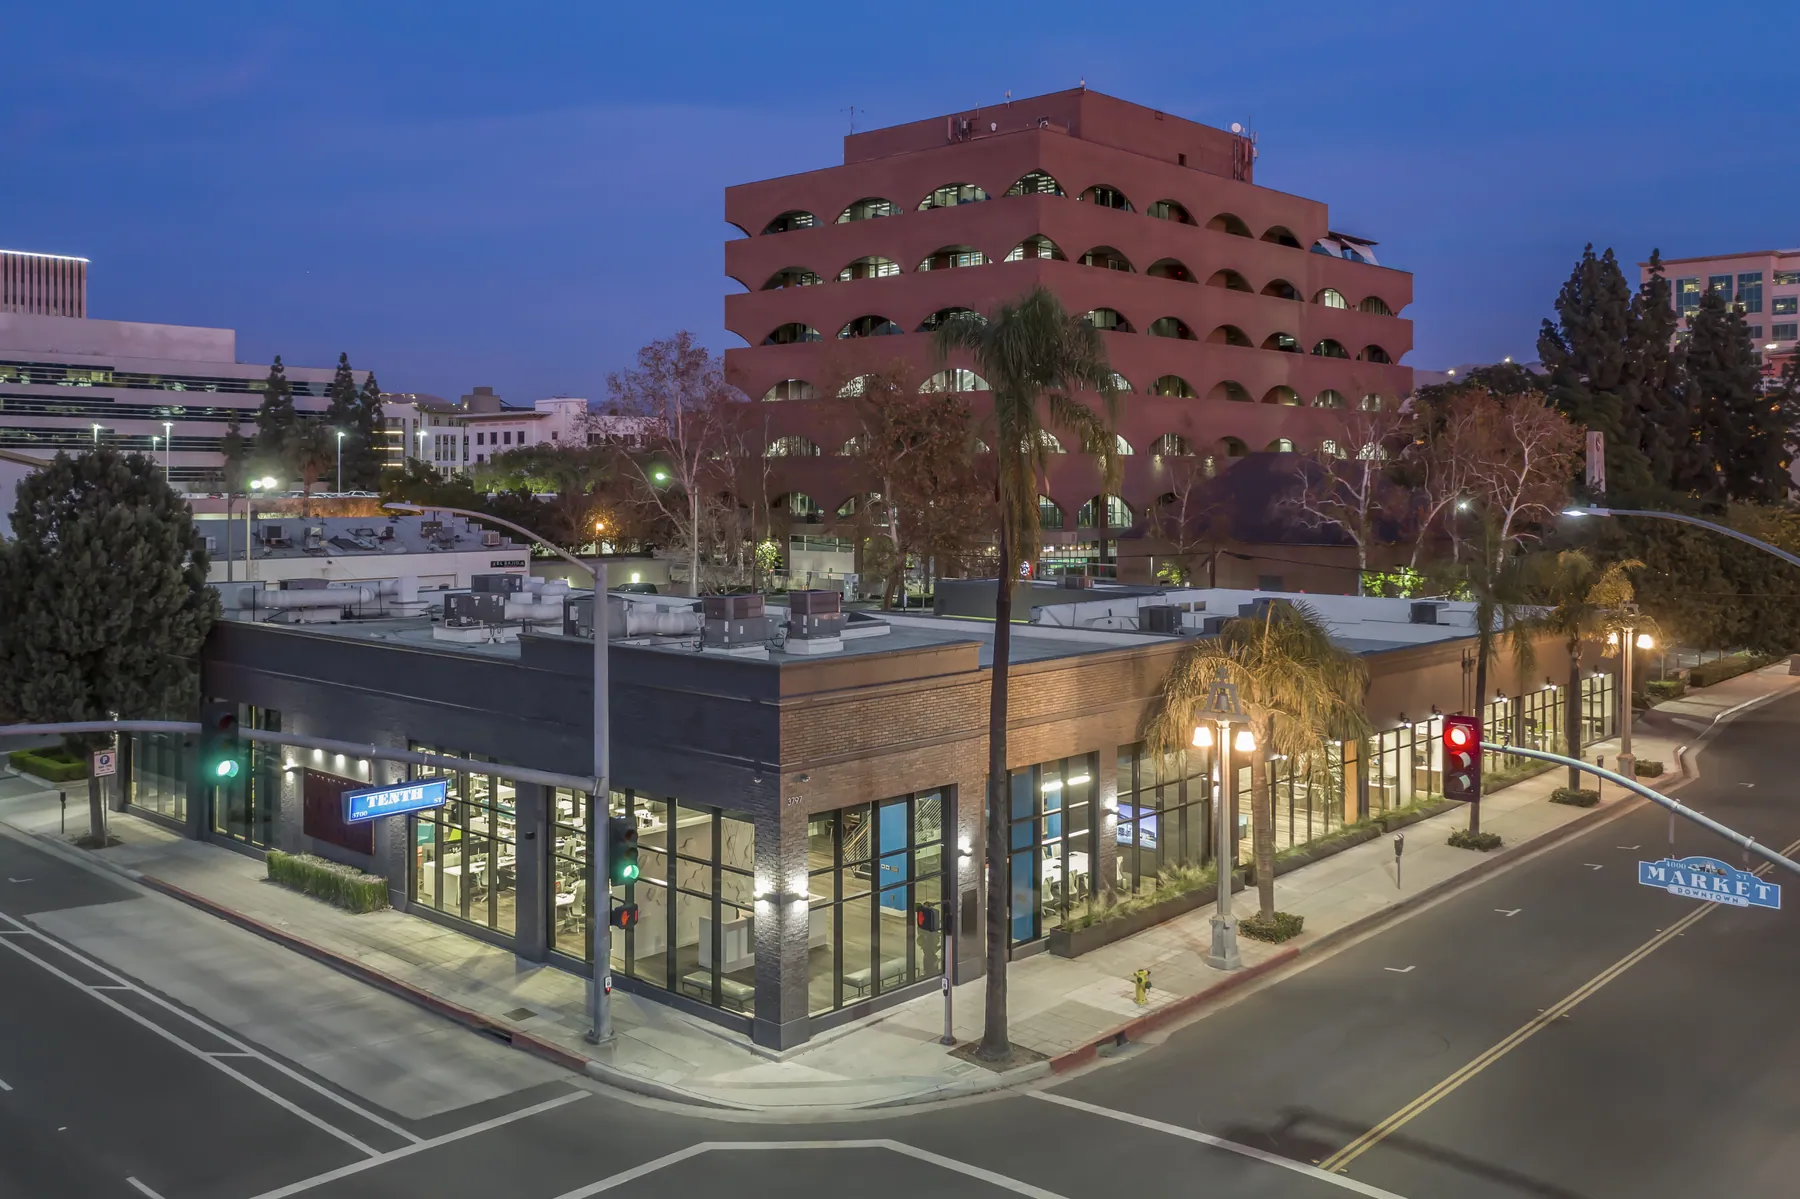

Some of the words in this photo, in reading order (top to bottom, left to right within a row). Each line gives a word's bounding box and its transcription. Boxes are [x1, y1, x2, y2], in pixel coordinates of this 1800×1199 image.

[367, 788, 424, 807] TENTH
[787, 795, 803, 807] 3797
[352, 811, 368, 819] 3700
[1666, 860, 1687, 870] 4000
[1647, 865, 1771, 900] MARKET
[1735, 873, 1748, 881] ST
[1677, 887, 1739, 904] DOWNTOWN
